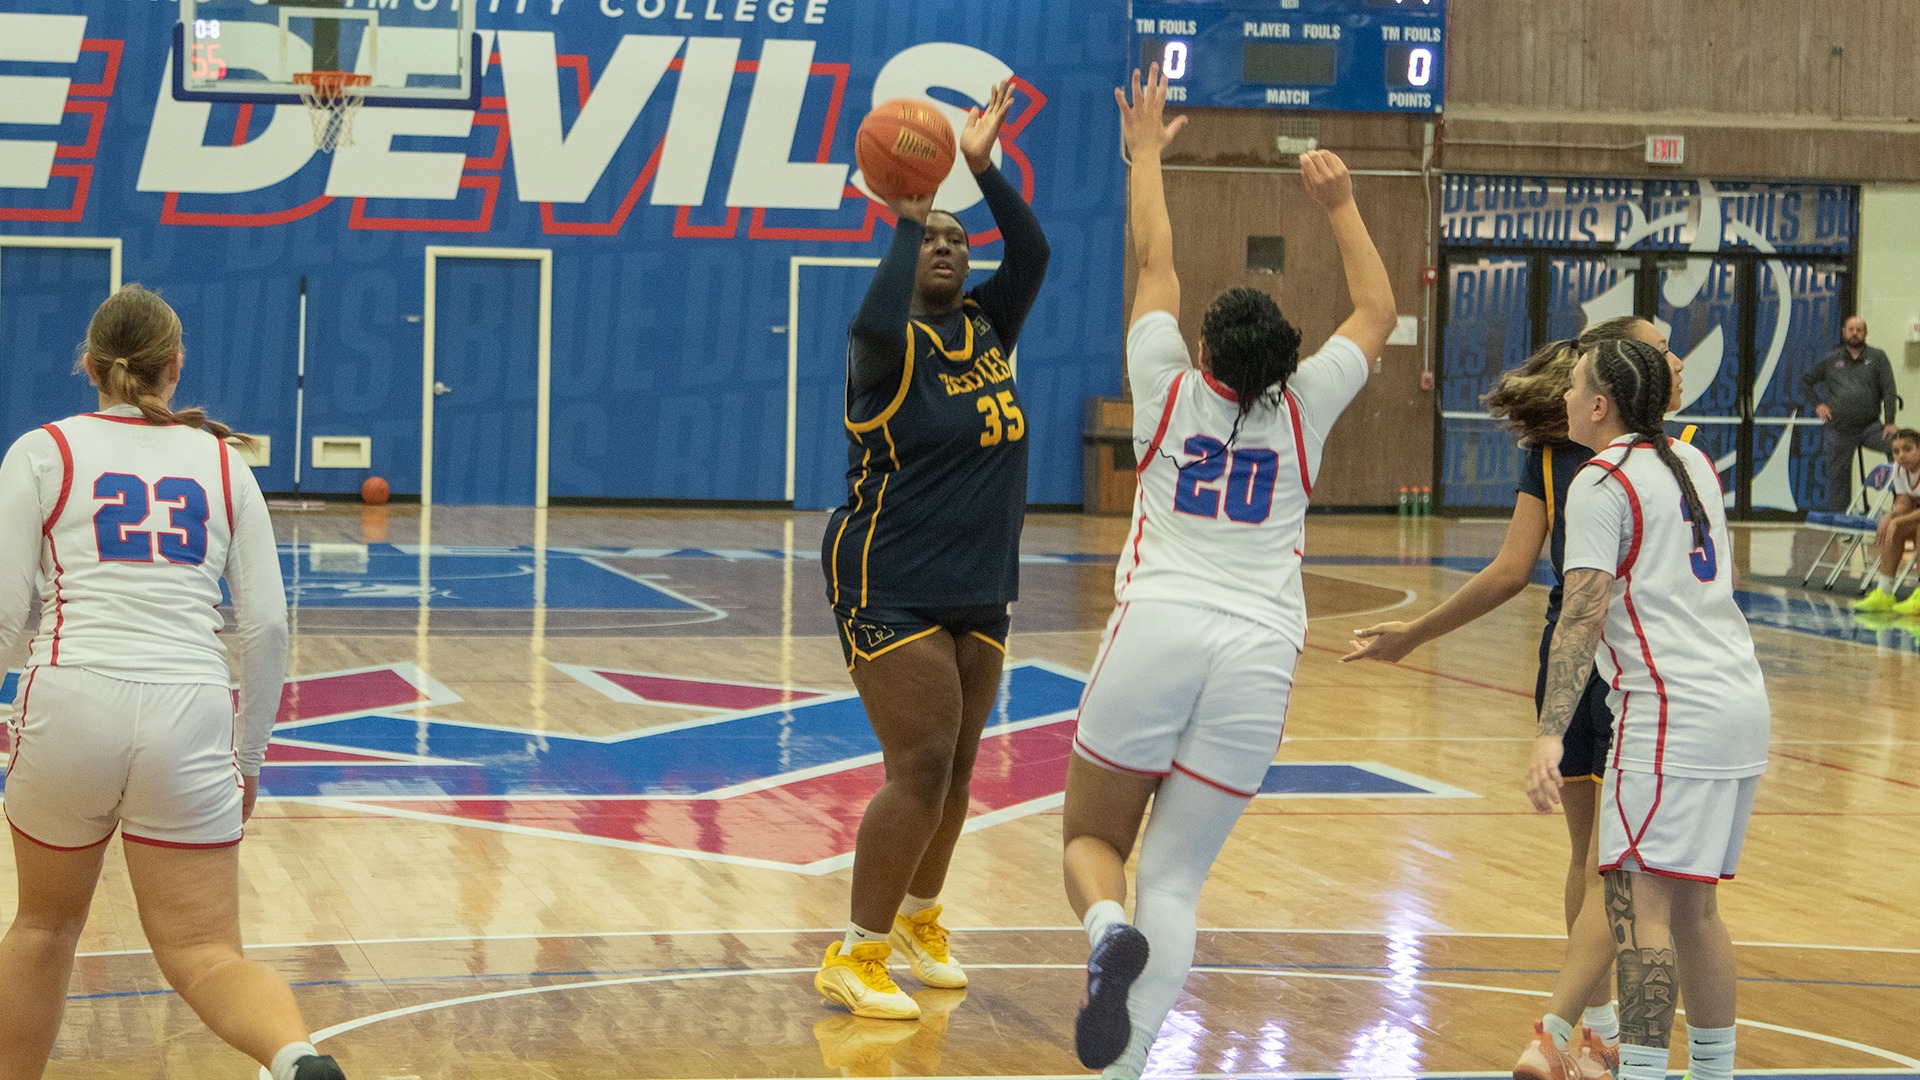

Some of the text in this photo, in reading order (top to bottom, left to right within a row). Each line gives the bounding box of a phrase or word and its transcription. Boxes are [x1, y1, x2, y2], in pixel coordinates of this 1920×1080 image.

[600, 0, 829, 24] COLLEGE
[1136, 19, 1197, 35] TM FOULS
[1244, 22, 1341, 39] PLAYER FOULS
[1381, 26, 1441, 42] TM FOULS
[1163, 42, 1187, 79] 0
[1407, 48, 1432, 86] 0
[1266, 90, 1309, 105] MATCH
[1388, 93, 1431, 108] POINTS
[136, 21, 1047, 247] DEVILS
[1653, 139, 1679, 160] EXIT
[1493, 205, 1599, 248] DEVILS
[976, 389, 1025, 448] 35
[1173, 433, 1279, 526] 20
[93, 471, 210, 567] 23
[1680, 493, 1718, 582] 3
